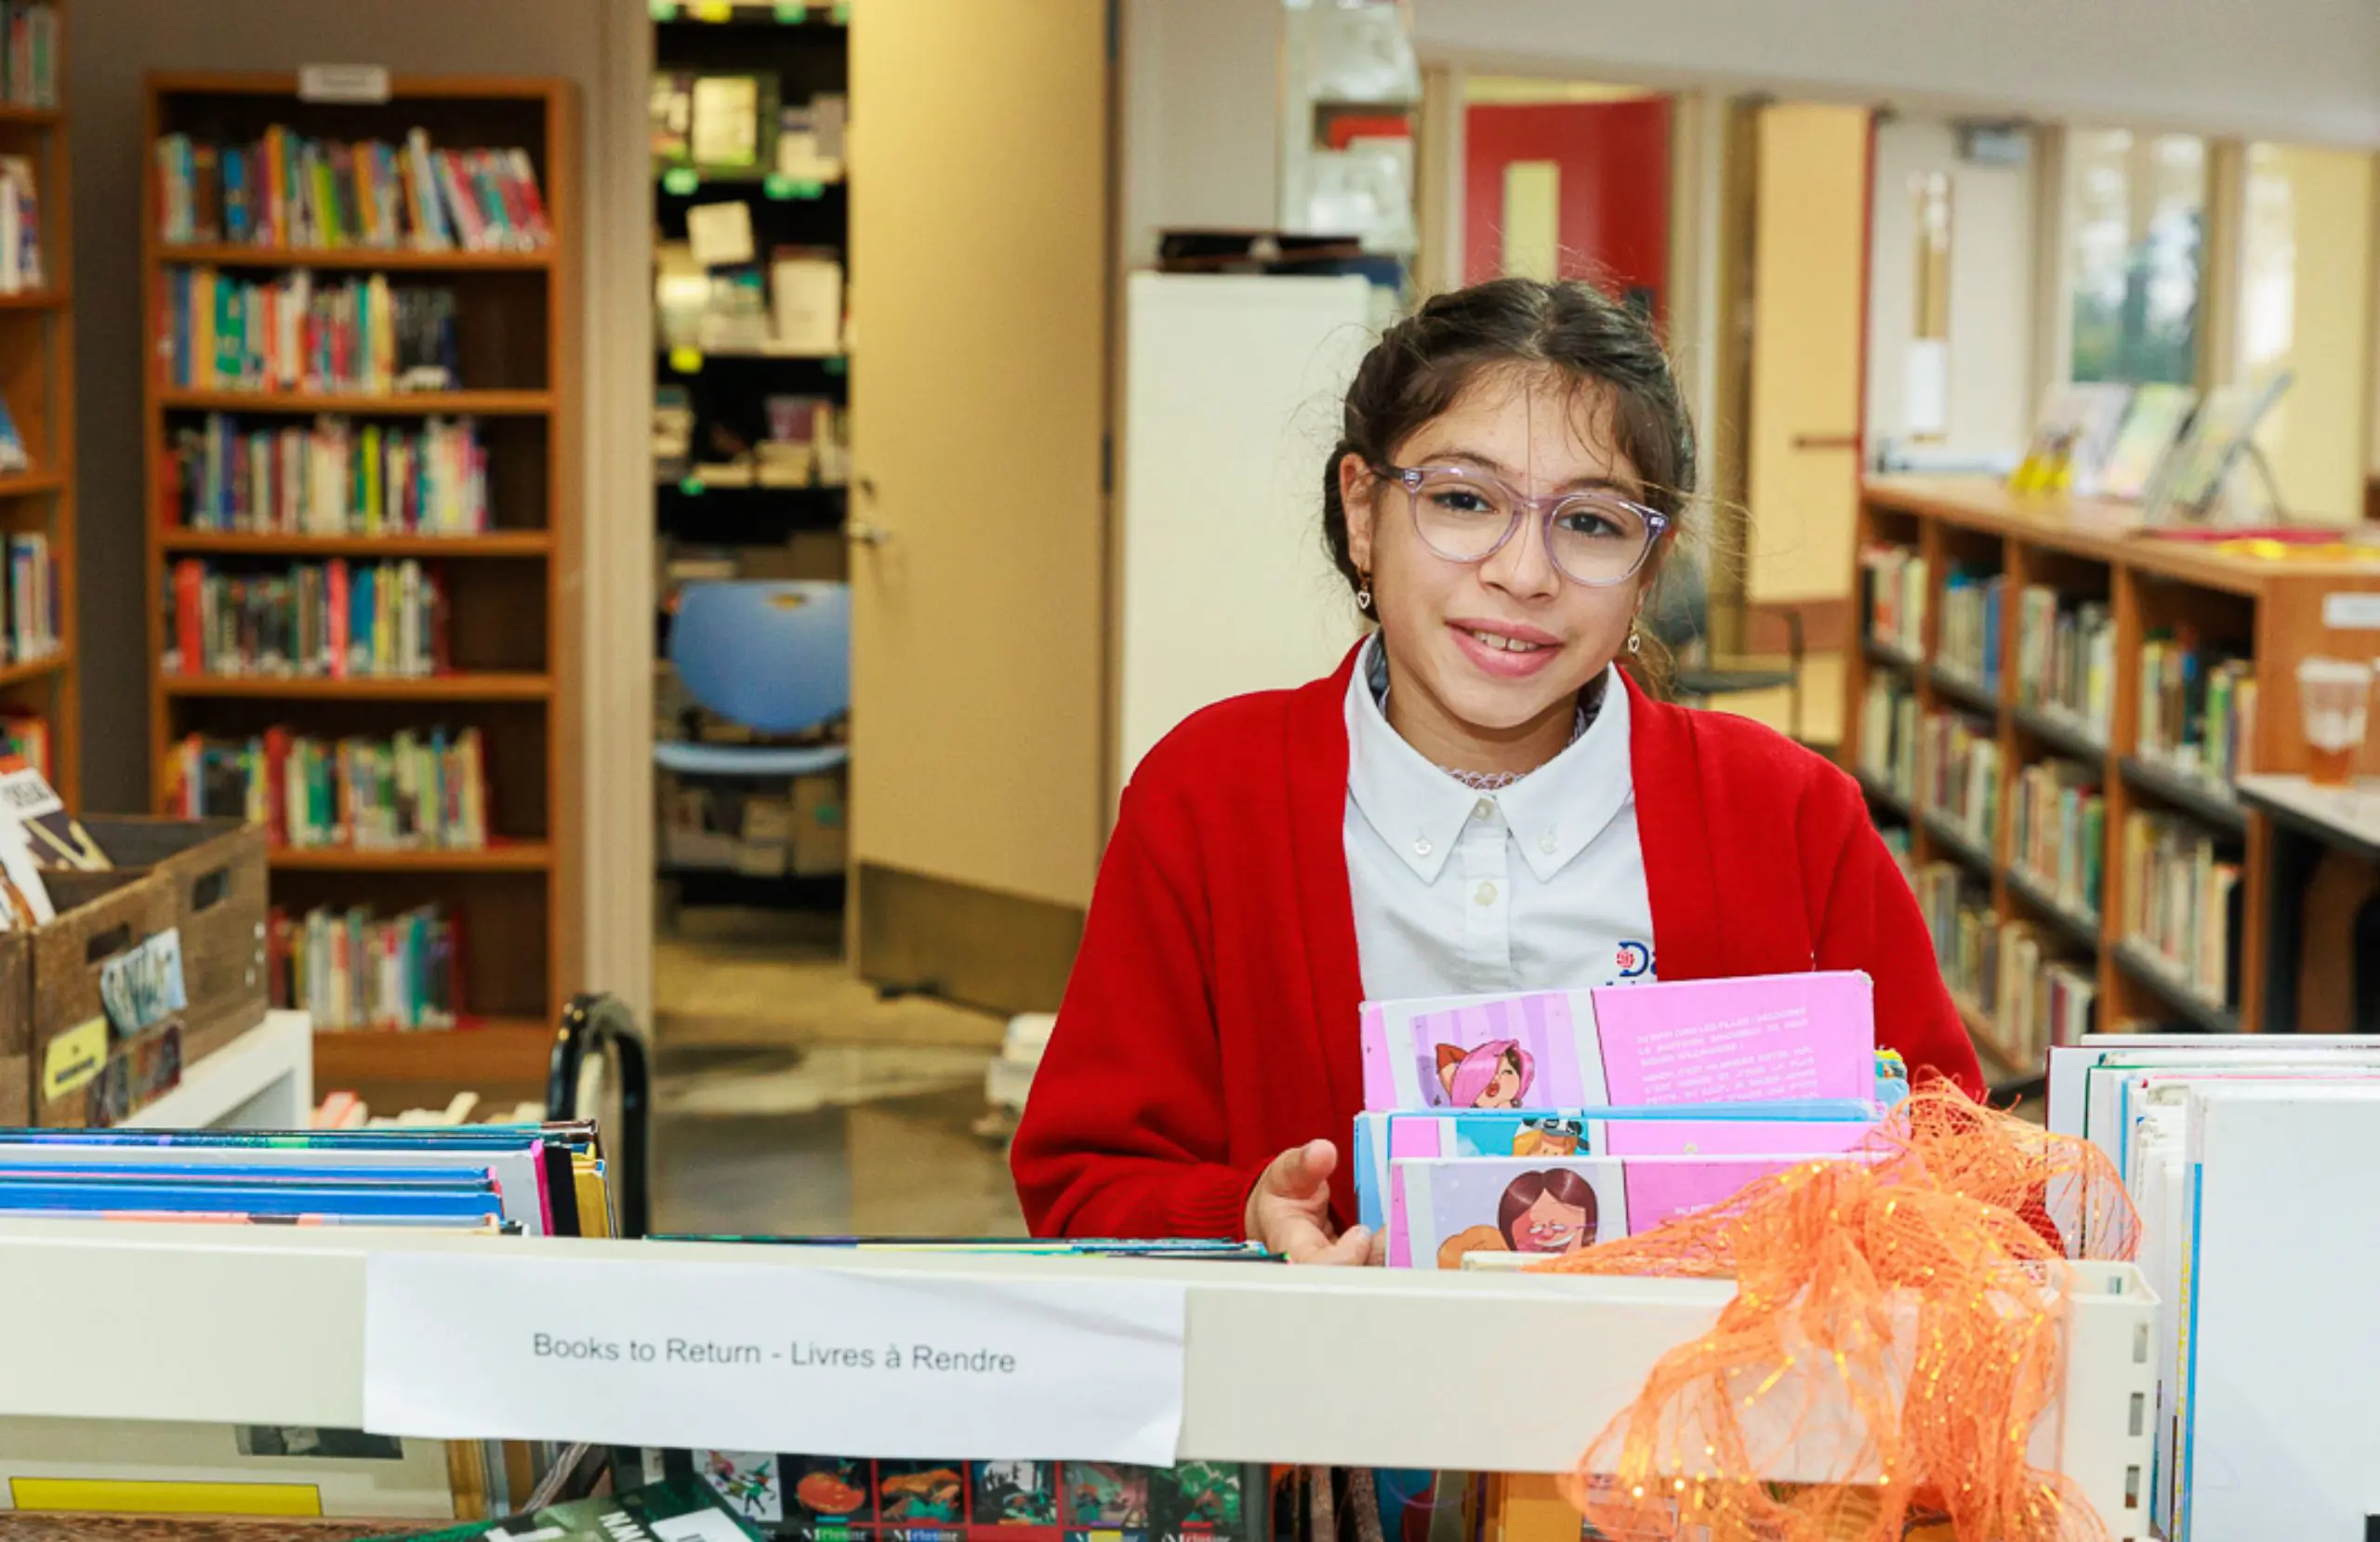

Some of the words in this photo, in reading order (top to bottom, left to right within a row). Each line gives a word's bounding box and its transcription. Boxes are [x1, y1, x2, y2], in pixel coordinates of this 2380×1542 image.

[533, 1332, 620, 1361] Books
[630, 1339, 656, 1363] to
[667, 1338, 761, 1364] Return
[791, 1341, 876, 1368] Livres
[884, 1343, 902, 1369] à
[912, 1345, 1016, 1374] Rendre
